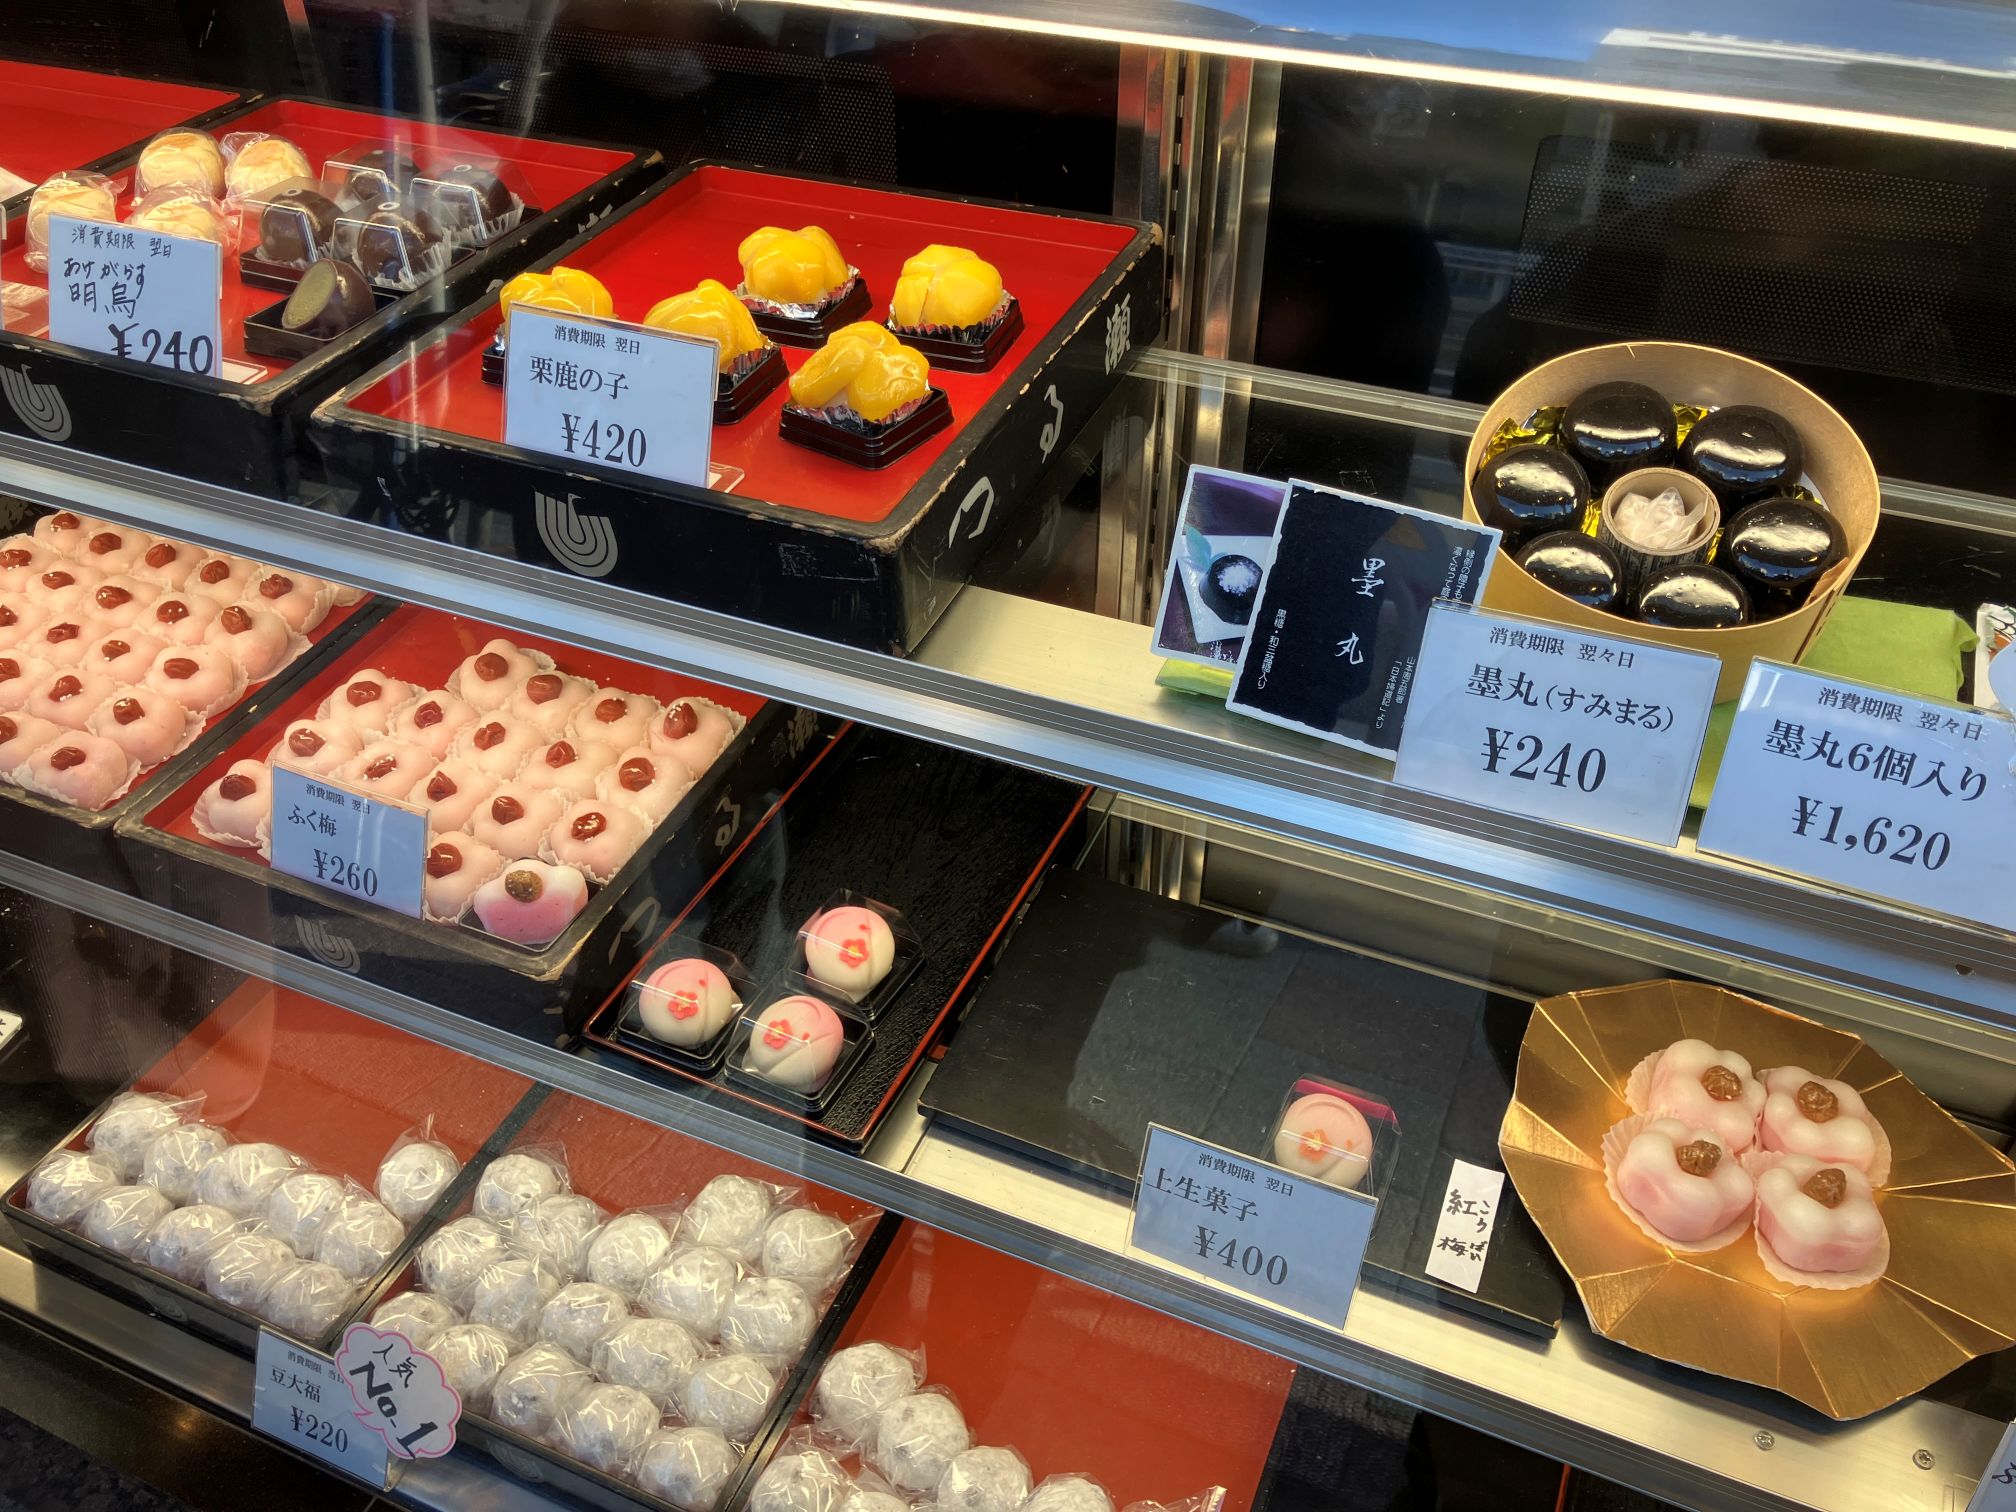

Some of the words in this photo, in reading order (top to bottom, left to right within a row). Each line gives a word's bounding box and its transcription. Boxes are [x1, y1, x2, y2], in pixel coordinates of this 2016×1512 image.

[72, 224, 135, 250] 消費期限
[150, 237, 172, 258] 翌日
[107, 322, 214, 375] ¥240
[554, 325, 606, 348] 消費期限
[615, 336, 640, 355] 翌日
[529, 355, 629, 400] 栗鹿の子
[560, 412, 647, 467] ¥420
[1489, 627, 1564, 656] 消費期限
[1576, 643, 1634, 669] 翌々日
[1818, 687, 1903, 723] 消費期限
[1916, 710, 1983, 742] 翌々日
[1481, 727, 1606, 793] ¥240
[1762, 719, 1987, 801] 墨丸6個入り
[288, 804, 337, 837] ふく梅
[306, 783, 345, 807] 消費期限
[352, 800, 370, 815] 翌日
[1792, 795, 1951, 871] ¥1,620
[313, 848, 378, 897] ¥260
[1146, 1167, 1259, 1222] 上生菓子
[1198, 1153, 1256, 1184] 消費期限
[1264, 1177, 1294, 1197] 翌日
[1193, 1225, 1288, 1285] ¥400
[270, 1365, 321, 1404] 豆大福
[287, 1351, 322, 1374] 消費期限
[373, 1344, 417, 1388] 人気
[291, 1406, 349, 1453] ¥220
